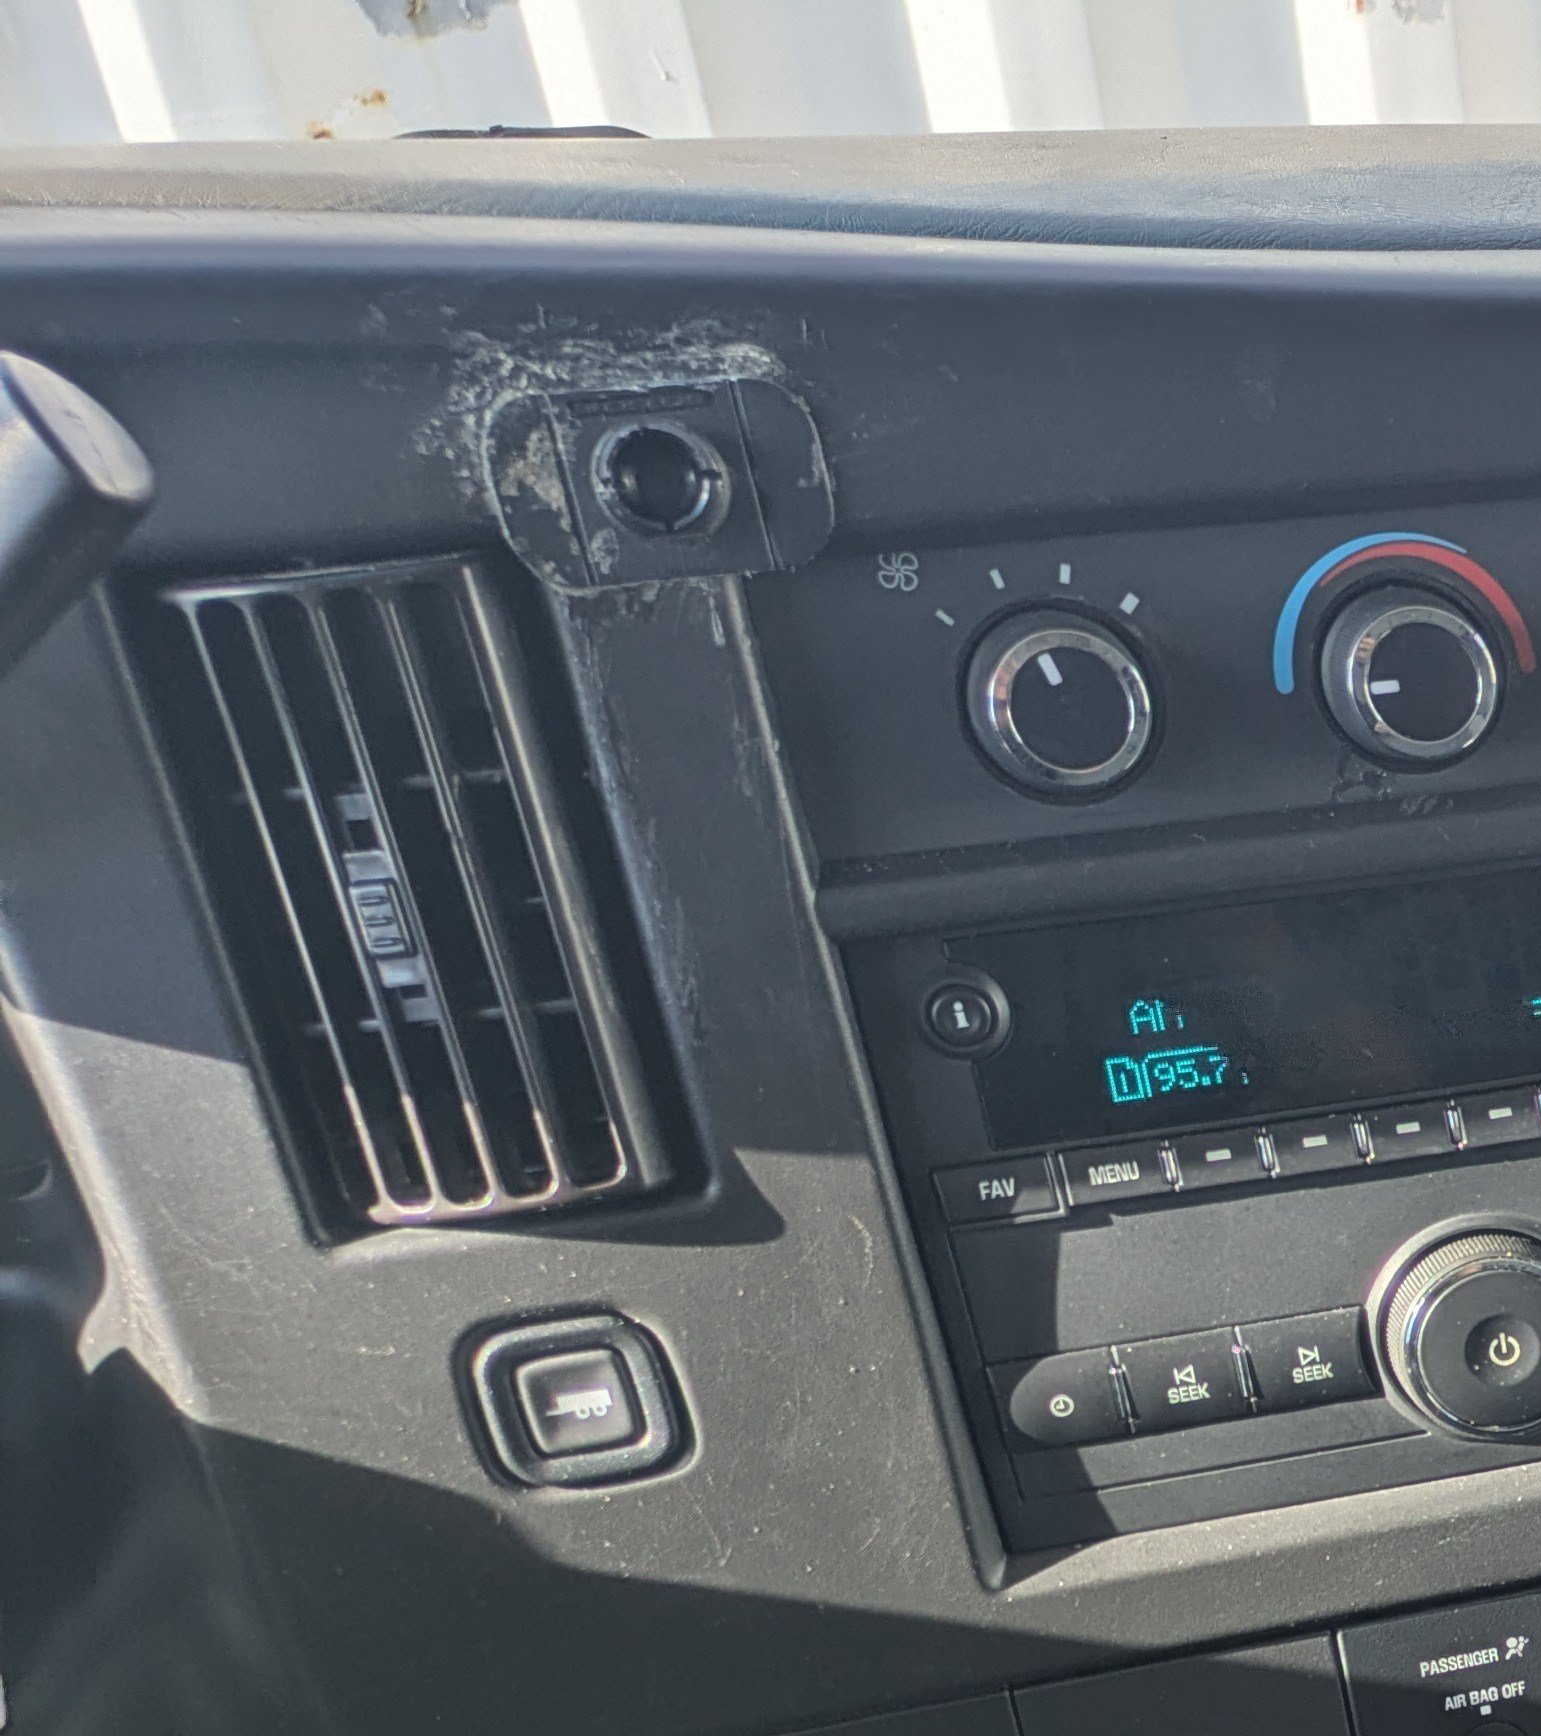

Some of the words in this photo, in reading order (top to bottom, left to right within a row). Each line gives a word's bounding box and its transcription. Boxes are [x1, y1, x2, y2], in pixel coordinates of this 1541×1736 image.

[1153, 1054, 1229, 1093] 95.7
[1087, 1159, 1141, 1187] MENU
[978, 1176, 1016, 1201] FAV
[1292, 1361, 1335, 1385] SEEK
[1167, 1381, 1211, 1405] SEEK
[1419, 1647, 1500, 1678] PASSENGER
[1444, 1692, 1467, 1712] AIR
[1468, 1686, 1500, 1707] BAG
[1501, 1680, 1526, 1700] OFF
